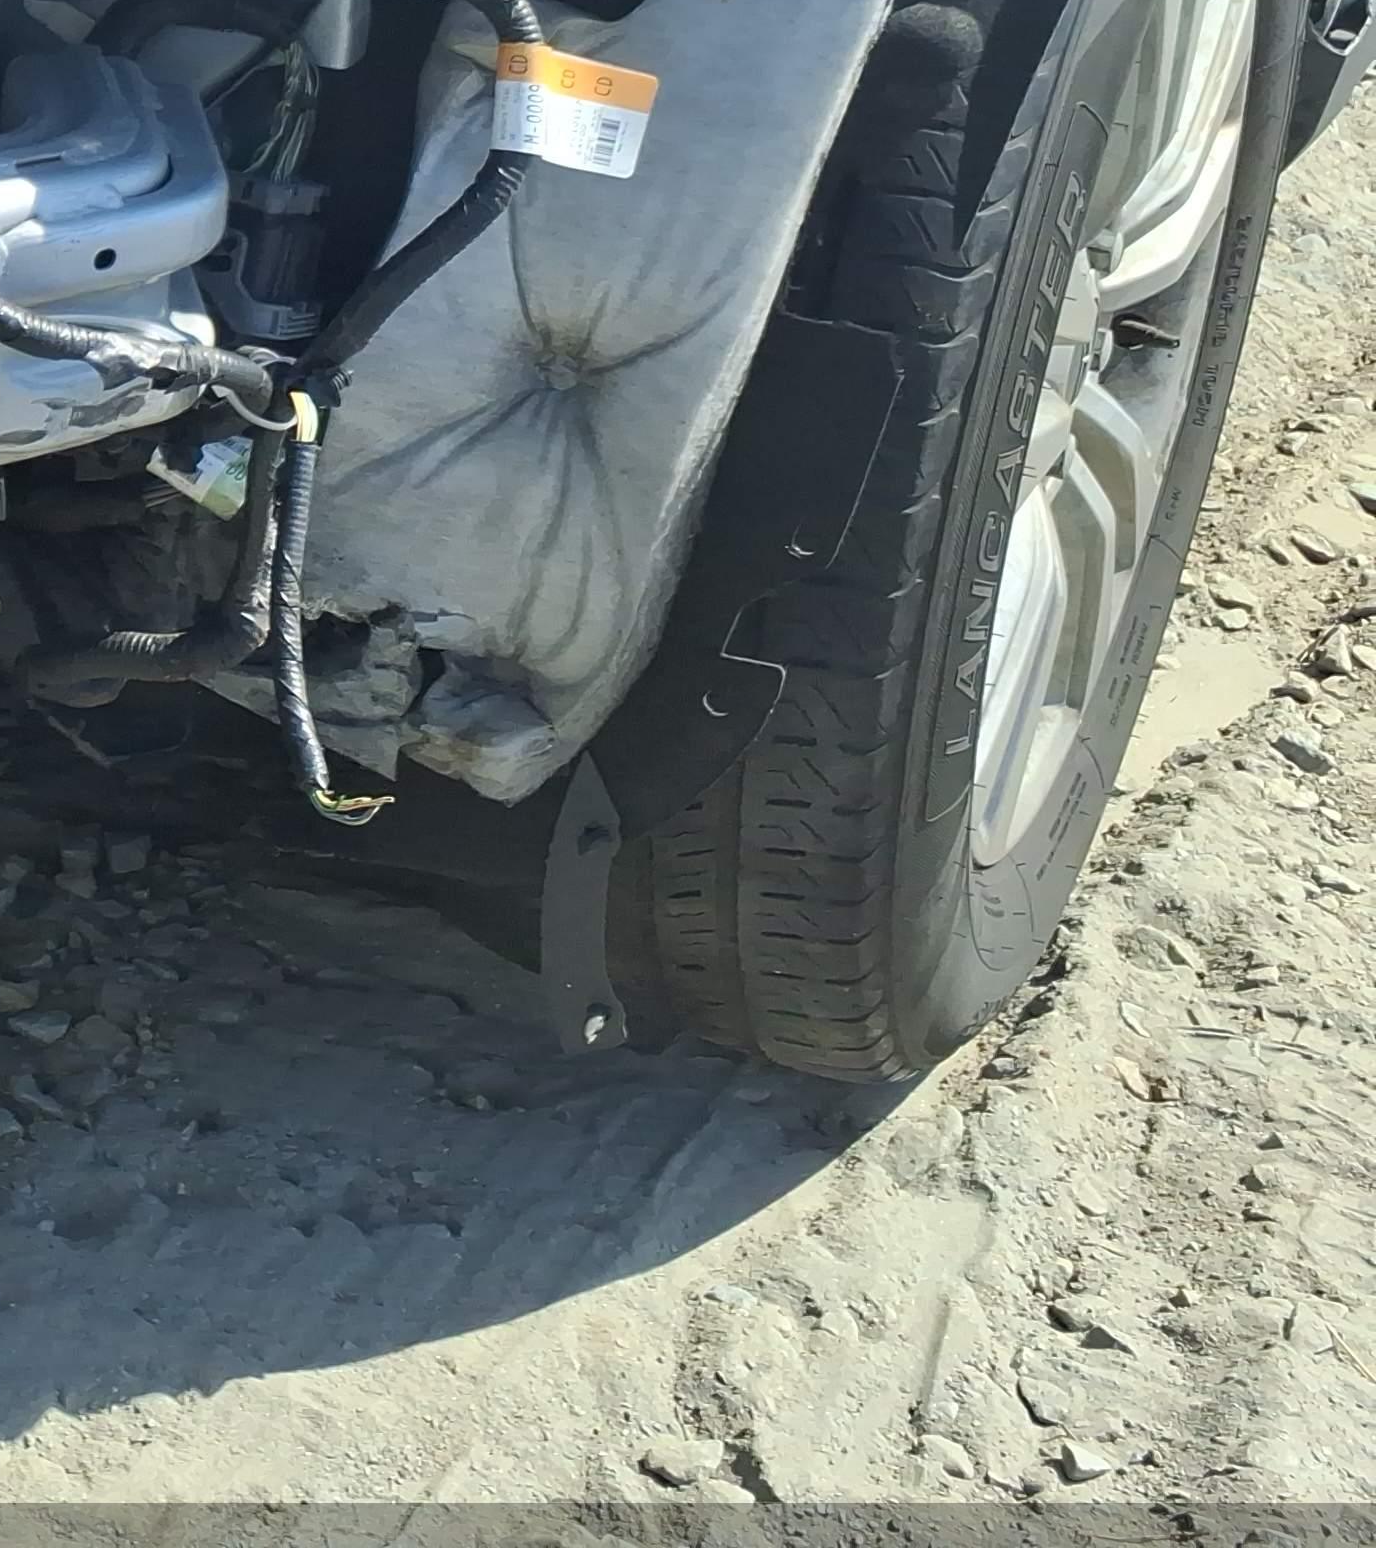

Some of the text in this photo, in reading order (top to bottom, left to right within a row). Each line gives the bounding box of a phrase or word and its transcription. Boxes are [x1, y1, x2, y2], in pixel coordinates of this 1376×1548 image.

[509, 54, 528, 75] CD
[561, 69, 576, 89] CD
[595, 76, 614, 97] CD
[944, 170, 1086, 758] LANCASTER
